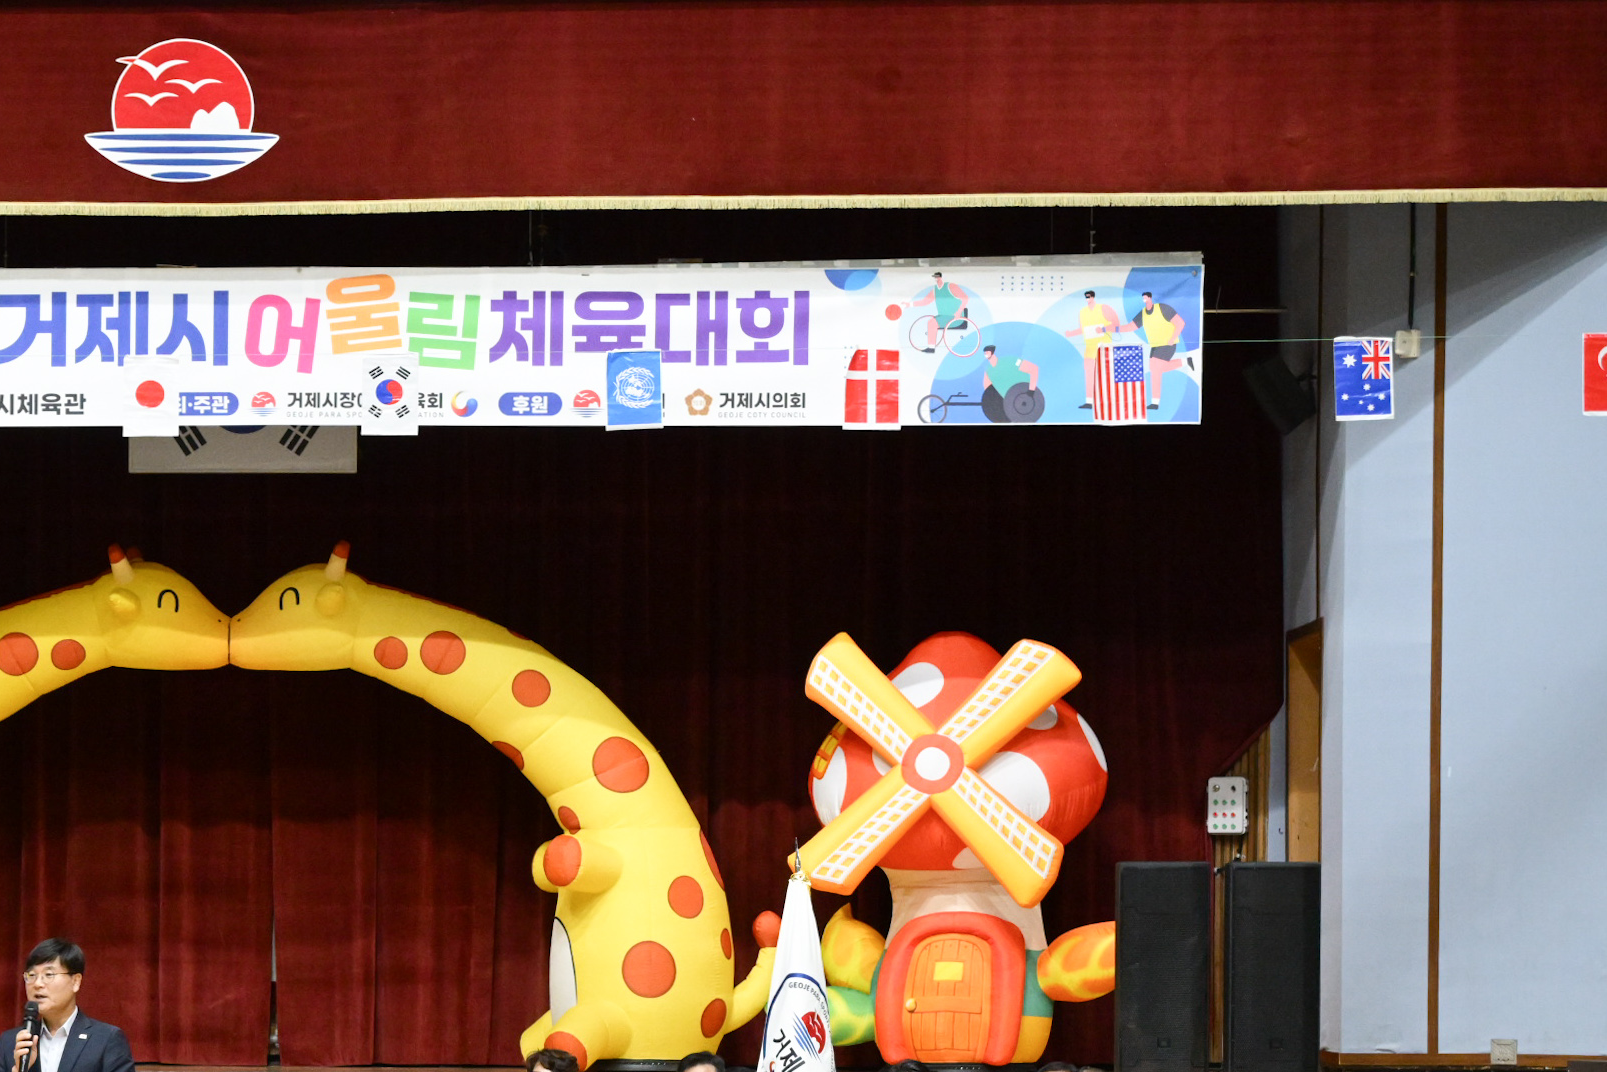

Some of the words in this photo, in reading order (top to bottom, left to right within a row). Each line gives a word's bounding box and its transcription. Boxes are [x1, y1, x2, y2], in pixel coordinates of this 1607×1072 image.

[180, 395, 230, 414] ·주관
[512, 395, 549, 414] 후원
[719, 392, 806, 409] 거제시의회
[788, 981, 811, 992] GEOJE
